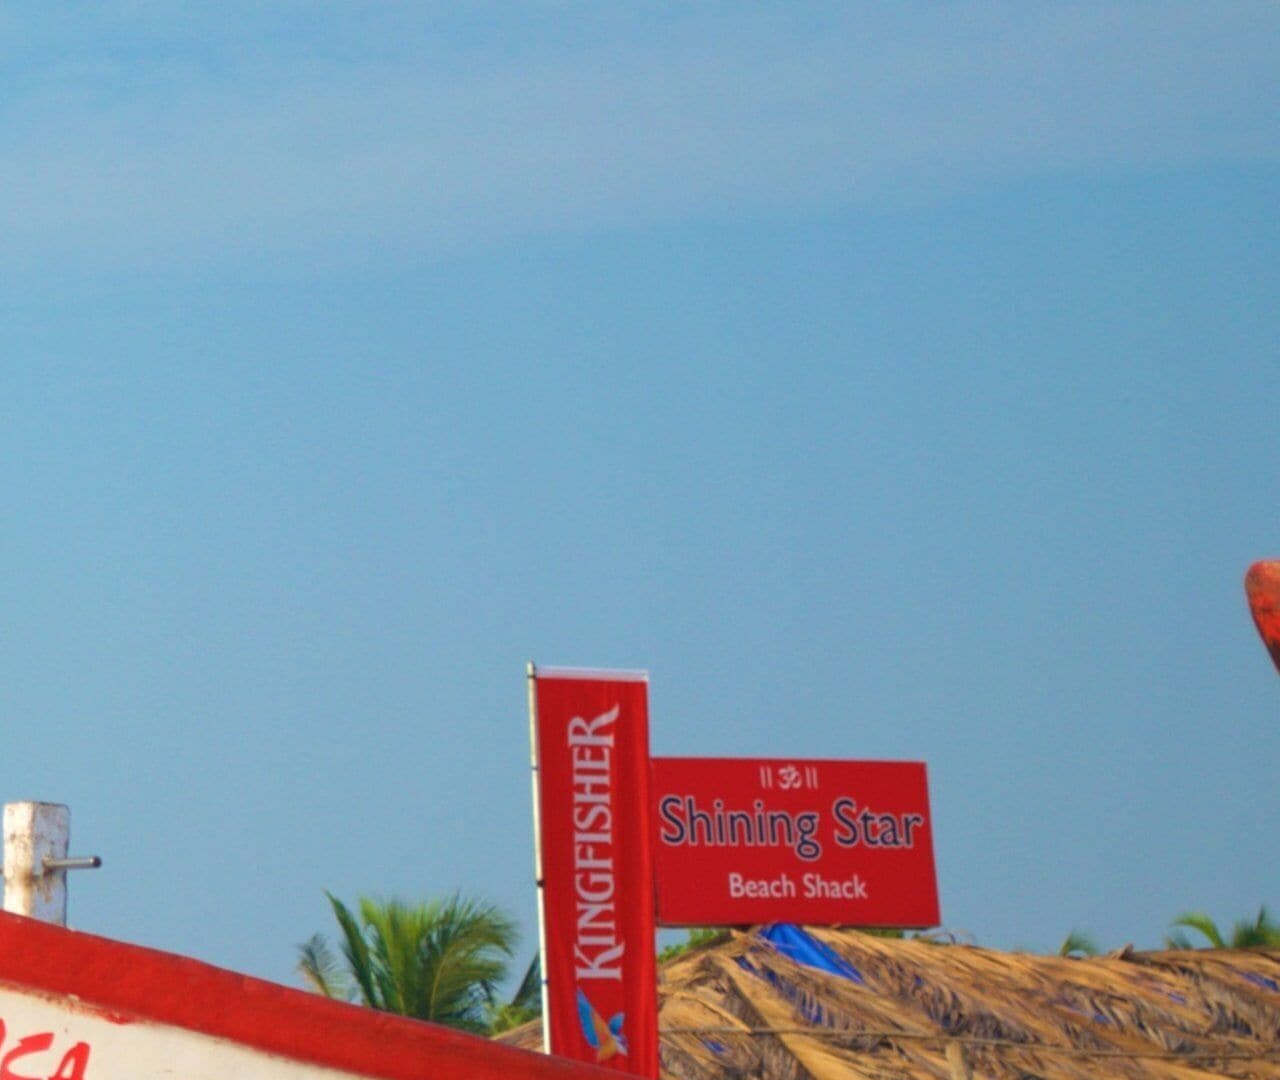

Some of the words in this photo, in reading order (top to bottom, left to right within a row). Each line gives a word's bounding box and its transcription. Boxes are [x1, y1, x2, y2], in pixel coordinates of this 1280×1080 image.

[568, 704, 624, 980] KINGFISHER
[659, 795, 822, 862] Shining
[833, 797, 924, 849] Star
[728, 872, 796, 898] Beach
[803, 872, 868, 899] Shack
